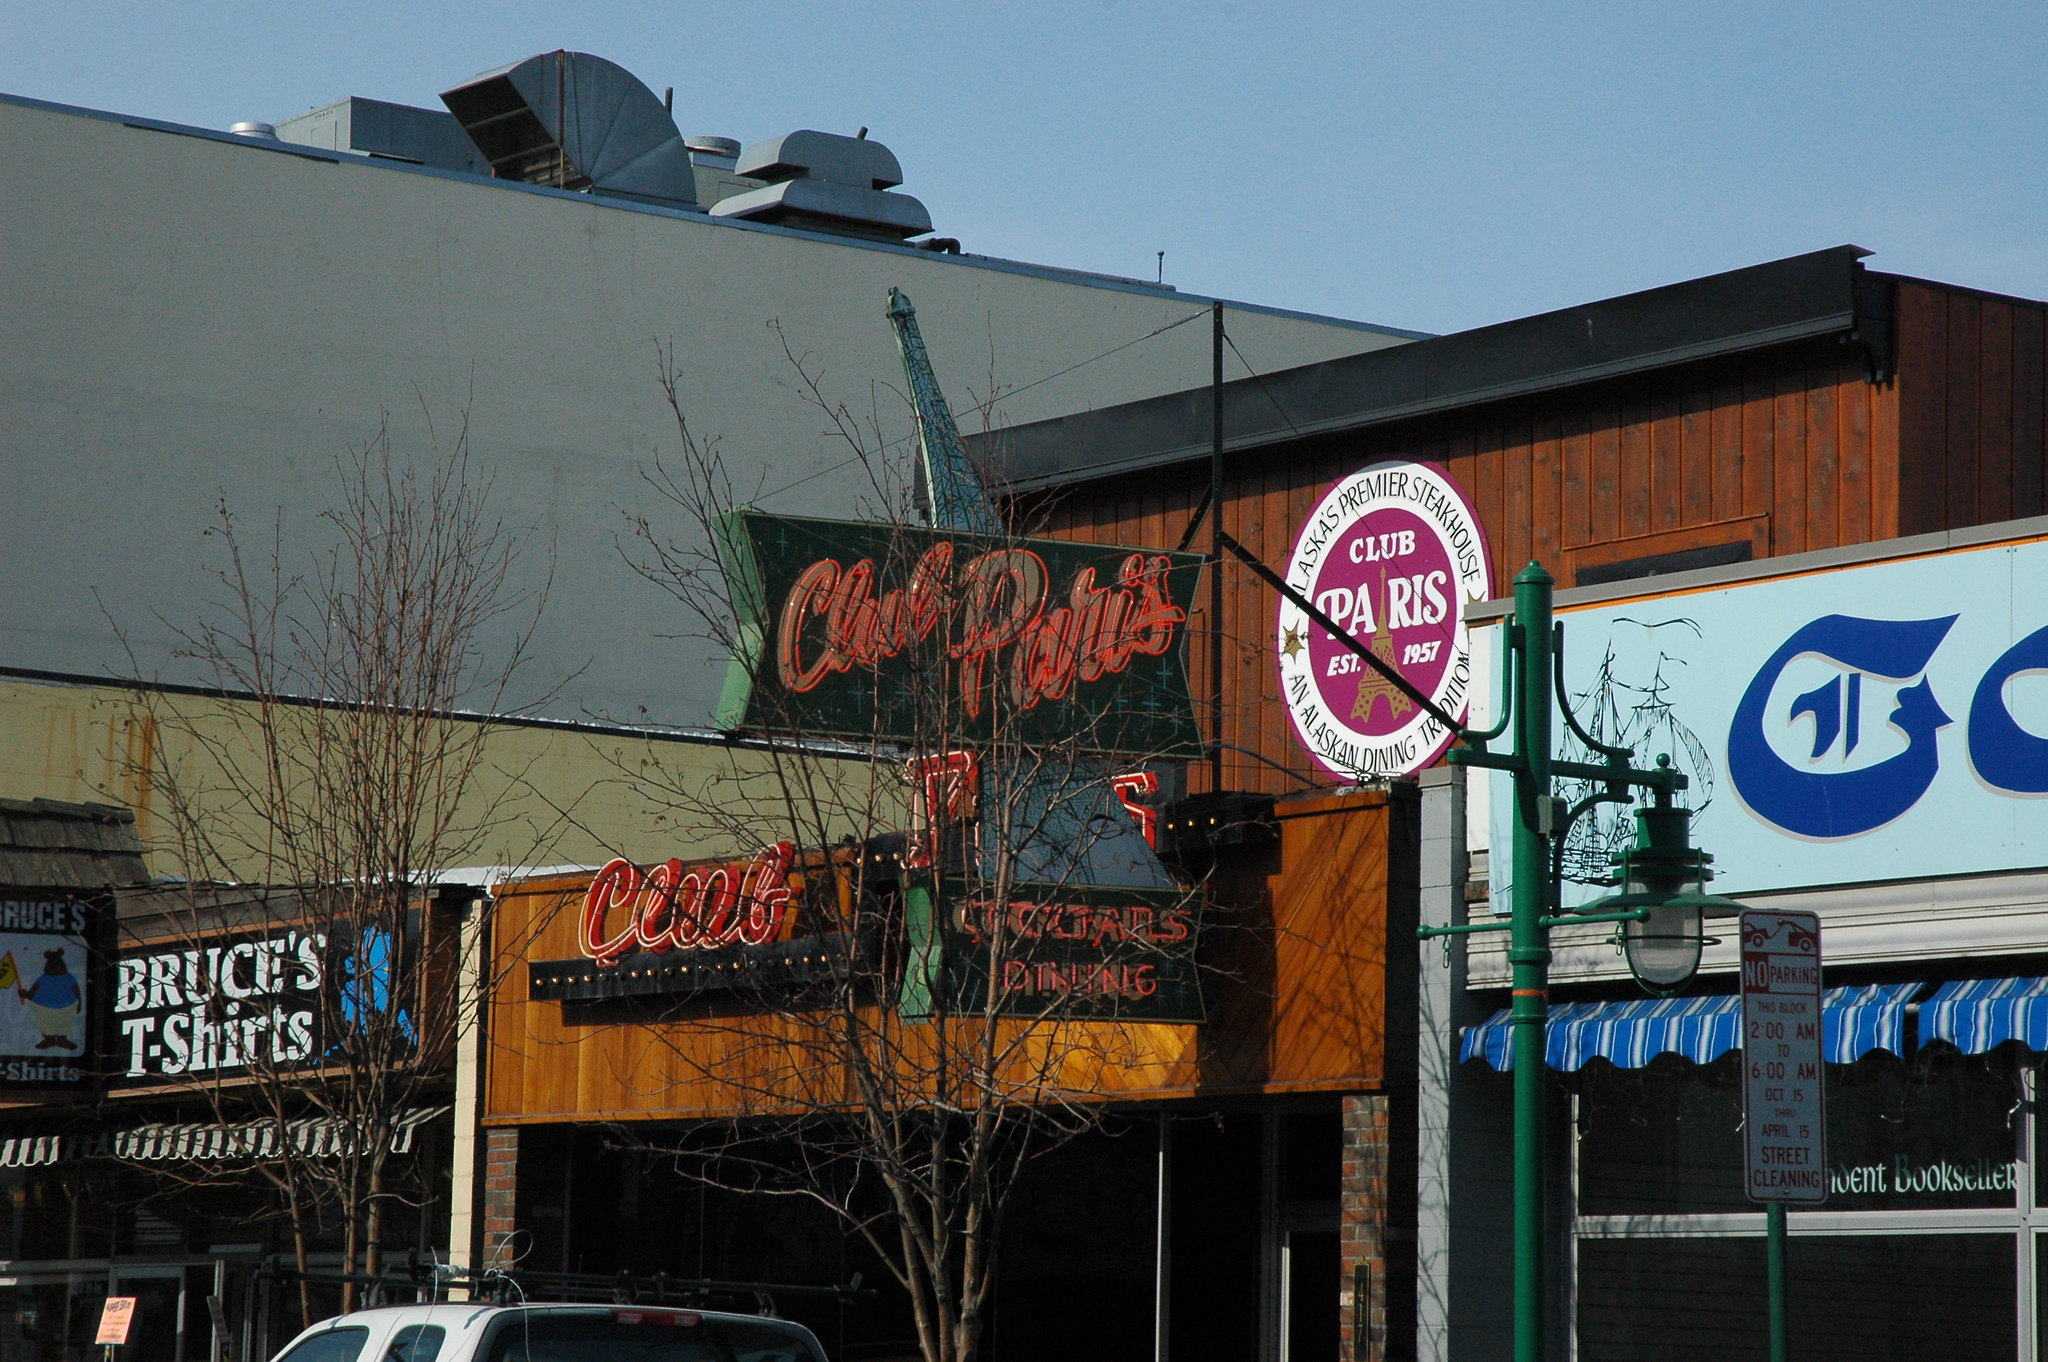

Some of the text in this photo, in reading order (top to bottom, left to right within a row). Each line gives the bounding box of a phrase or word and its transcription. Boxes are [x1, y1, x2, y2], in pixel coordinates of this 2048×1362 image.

[1291, 472, 1481, 606] LASKA'S PREMIER STEAKHOUSE
[1350, 530, 1416, 564] CLUB
[1317, 570, 1447, 640] PARIS
[778, 541, 1186, 718] Club Paris
[1326, 640, 1442, 677] EST. 1957
[1289, 651, 1469, 772] AN ALASKAN DINING TRDITIO
[114, 930, 326, 1012] BRUCE'S
[1002, 960, 1158, 1000] DINING
[1745, 961, 1817, 988] NO PARKING
[1757, 1001, 1807, 1015] THIS BLOCK
[122, 1002, 313, 1078] T-Shirts
[1751, 1022, 1815, 1040] 2:00 AM
[1777, 1044, 1790, 1058] TO
[1752, 1062, 1816, 1080] 6:00 AM
[1765, 1088, 1804, 1103] OCT 15
[1775, 1108, 1796, 1118] THRU
[1762, 1124, 1809, 1139] APRIL 15
[1761, 1146, 1811, 1165] STREET
[1753, 1169, 1820, 1188] CLEANING
